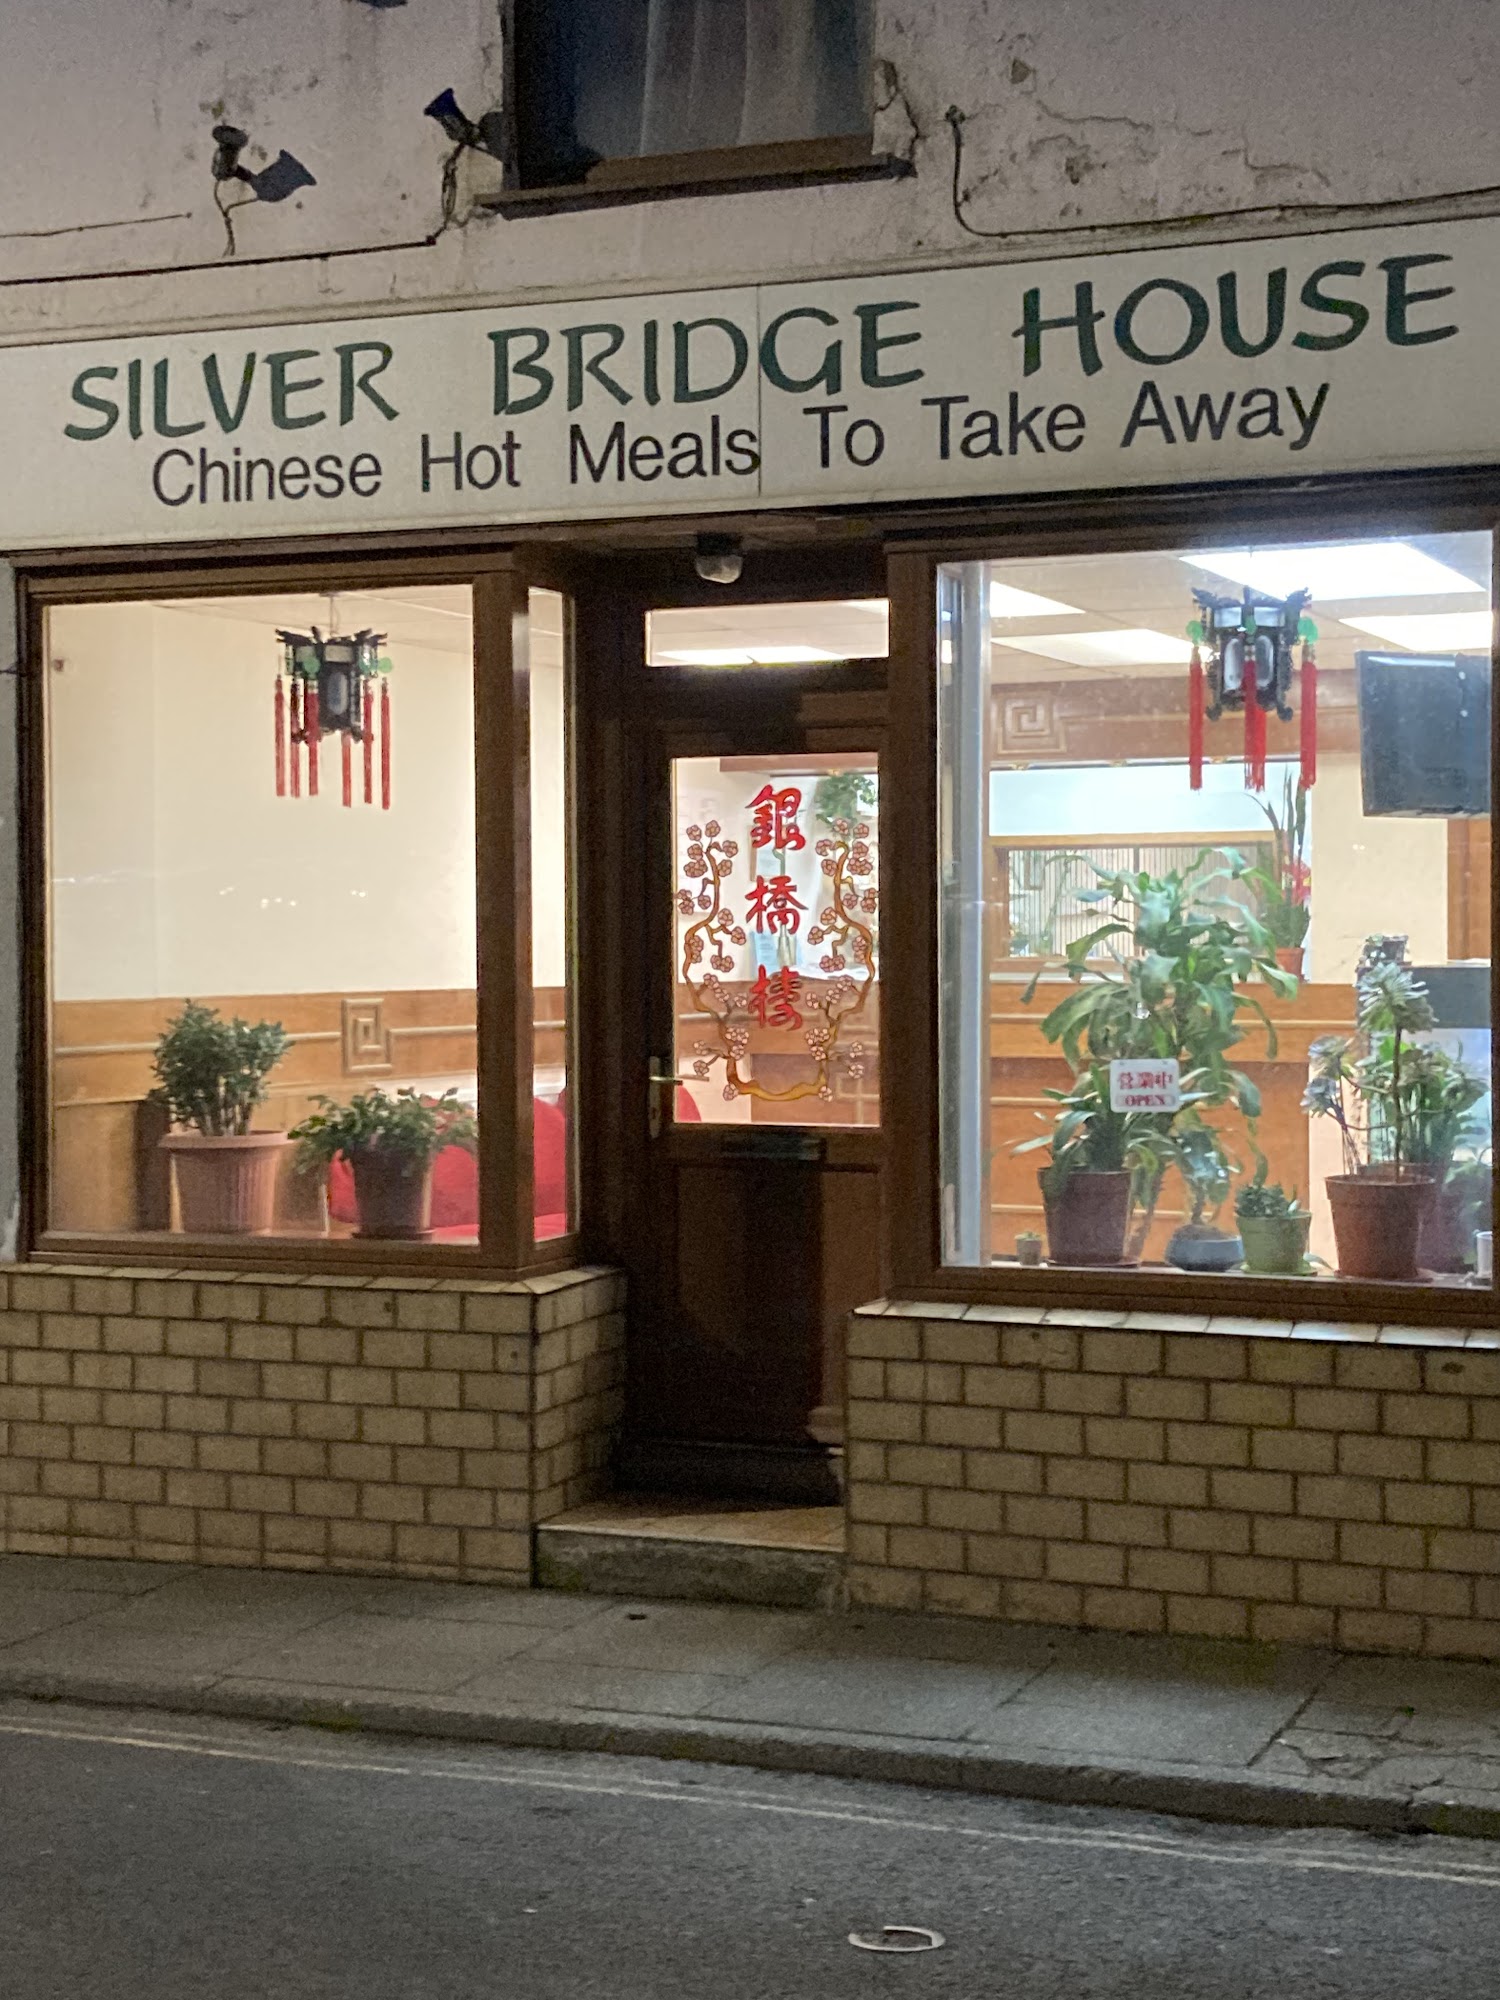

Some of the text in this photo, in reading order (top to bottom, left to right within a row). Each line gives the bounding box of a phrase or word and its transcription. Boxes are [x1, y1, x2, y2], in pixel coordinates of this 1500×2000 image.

[63, 253, 1460, 442] SILVER BRIDGE HOUSE
[152, 380, 1330, 507] Chinese Hot Meals To Take Away
[1125, 1094, 1166, 1107] OPEN
